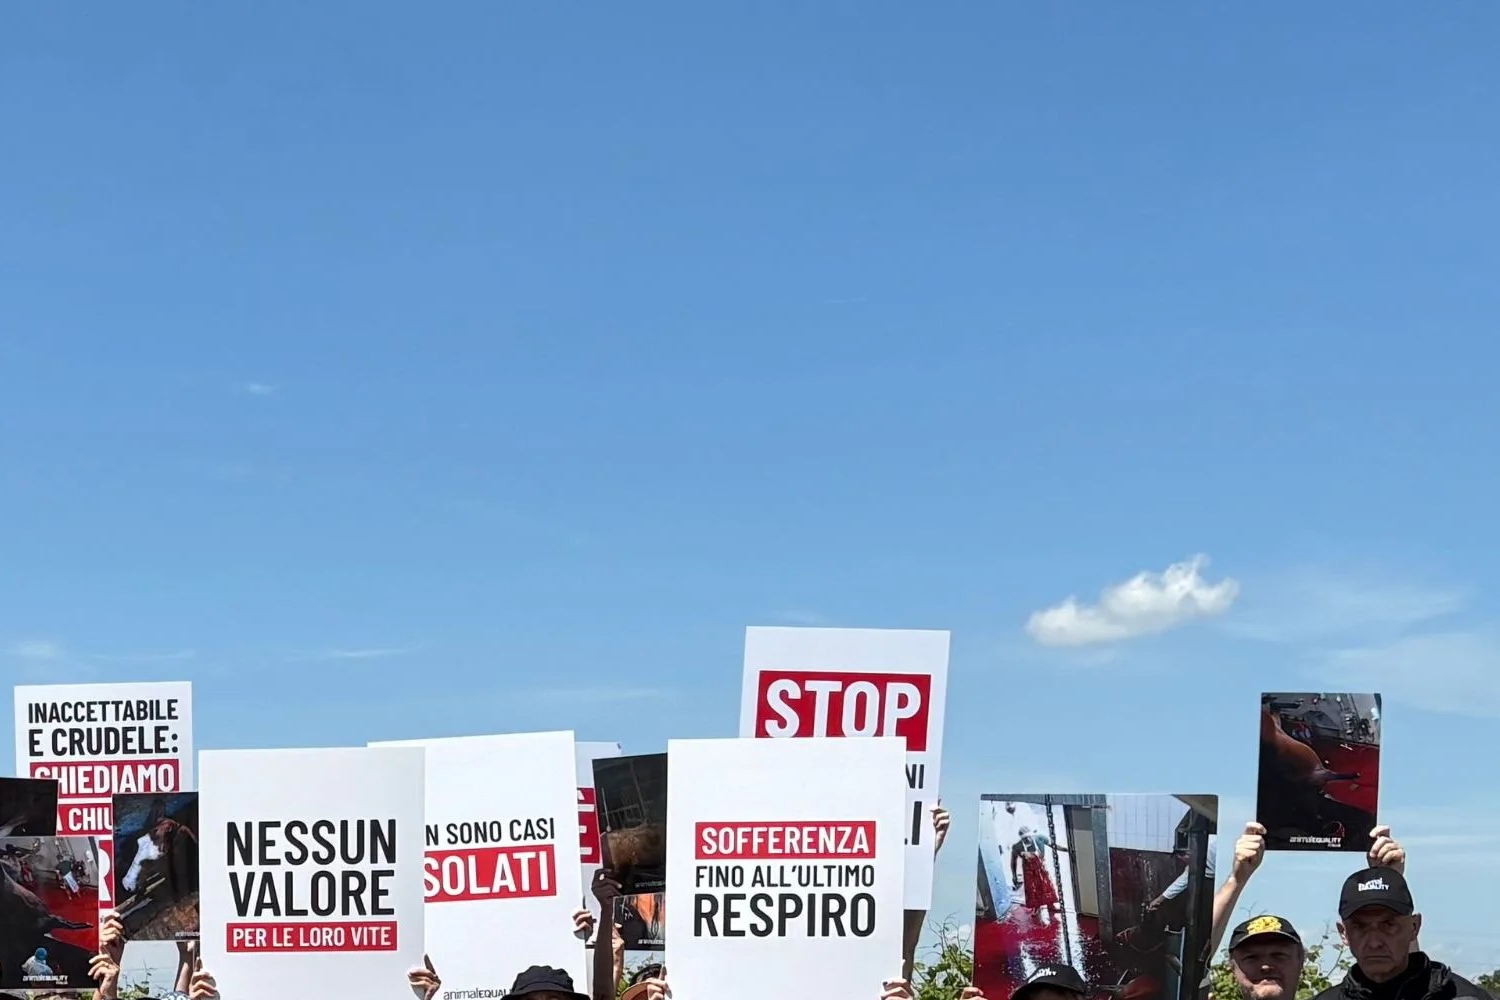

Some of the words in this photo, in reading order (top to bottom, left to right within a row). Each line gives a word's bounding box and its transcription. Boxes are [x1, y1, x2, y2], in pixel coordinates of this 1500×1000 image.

[29, 699, 178, 723] INACCETTABILE
[766, 679, 922, 738] STOP
[29, 729, 43, 756] E
[52, 726, 178, 756] CRUDELE:
[227, 819, 396, 866] NESSUN
[447, 821, 501, 844] SONO
[510, 818, 554, 841] CASI
[702, 827, 869, 854] SOFFERENZA
[424, 851, 549, 898] SOLATI
[696, 866, 743, 887] FINO
[229, 870, 394, 916] VALORE
[694, 893, 875, 937] RESPIRO
[234, 928, 266, 947] PER
[273, 928, 293, 946] LE
[300, 927, 344, 946] LORO
[351, 927, 391, 945] VITE
